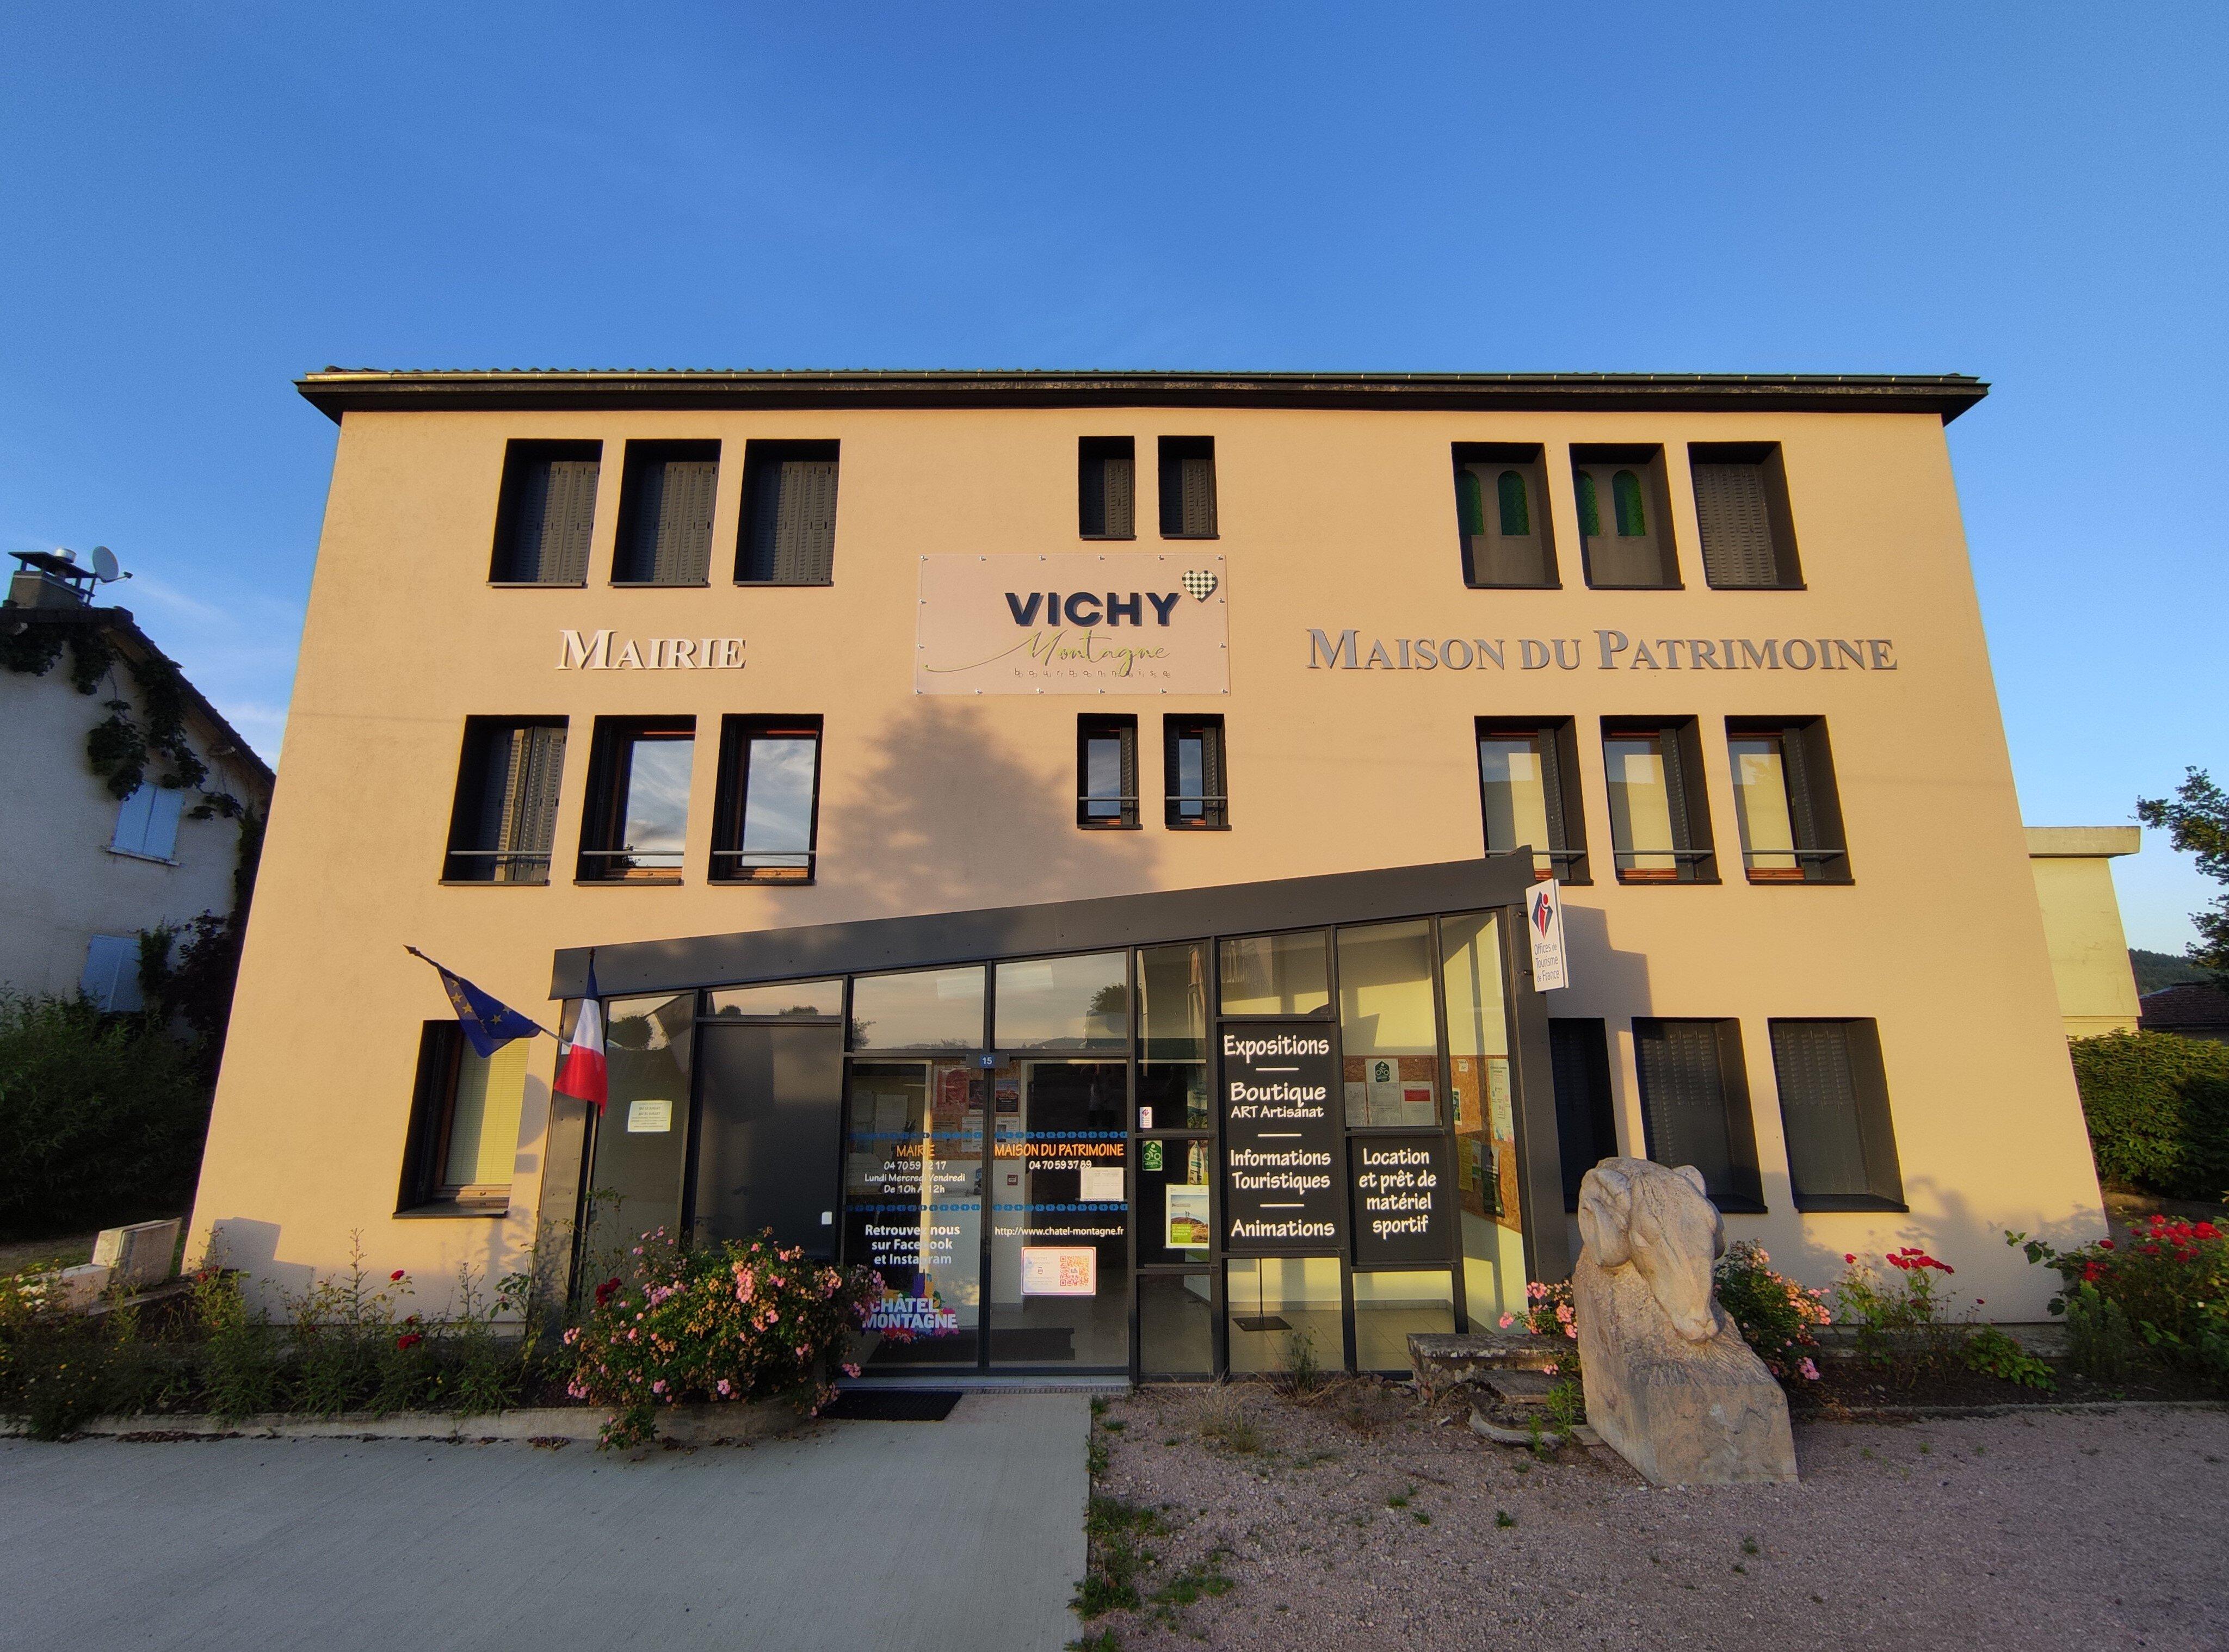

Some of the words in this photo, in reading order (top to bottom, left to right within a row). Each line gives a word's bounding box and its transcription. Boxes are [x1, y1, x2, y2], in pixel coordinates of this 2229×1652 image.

[1005, 592, 1180, 627] VICHY
[555, 629, 746, 670] MAIRIE
[1007, 627, 1171, 677] Montagne
[1305, 628, 1505, 670] MAISON
[1517, 639, 1582, 670] DU
[1592, 629, 1898, 670] PATRIMOINE
[1014, 668, 1170, 678] bourbonnaise
[1534, 943, 1551, 955] Offices
[1552, 943, 1557, 951] de
[1535, 955, 1559, 969] Tourisme
[1537, 974, 1542, 982] de
[1542, 970, 1560, 981] France
[1224, 1034, 1330, 1063] Expositions
[1230, 1082, 1326, 1107] Boutique
[1230, 1106, 1259, 1118] ART
[1259, 1105, 1325, 1118] Artisanat
[897, 1144, 935, 1157] MAIRE
[994, 1143, 1039, 1156] MAISON
[1041, 1143, 1056, 1156] DU
[1059, 1143, 1125, 1156] PATRIMOINE
[1230, 1148, 1331, 1166] Informations
[1363, 1148, 1430, 1166] Location
[884, 1161, 896, 1170] 04
[898, 1161, 909, 1170] 70
[909, 1161, 921, 1170] 59
[924, 1161, 934, 1170] 2
[935, 1160, 947, 1170] 17
[1029, 1160, 1041, 1170] 04
[1042, 1160, 1054, 1170] 70
[1054, 1160, 1066, 1170] 59
[1067, 1160, 1079, 1170] 37
[1079, 1160, 1092, 1170] 89
[865, 1173, 887, 1182] Lundi
[888, 1173, 926, 1182] Mercred
[928, 1173, 966, 1182] Vendredi
[1232, 1171, 1331, 1195] Touristiques
[1359, 1174, 1378, 1188] et
[1380, 1170, 1415, 1194] prêt
[1417, 1170, 1437, 1187] de
[884, 1185, 896, 1193] De
[898, 1184, 916, 1193] 10h
[928, 1184, 945, 1193] 12h
[1366, 1191, 1432, 1210] matériel
[930, 1226, 961, 1235] nous
[995, 1226, 1125, 1238] http://www.chatel-montagne.fr
[1231, 1218, 1335, 1237] Animations
[1372, 1215, 1429, 1240] sportif
[872, 1241, 891, 1250] sur
[894, 1238, 953, 1250] Faceook
[874, 1254, 887, 1265] et
[890, 1253, 952, 1266] Instaram
[870, 1292, 940, 1313] CHÂTEL
[862, 1313, 958, 1328] MONTAGNE
